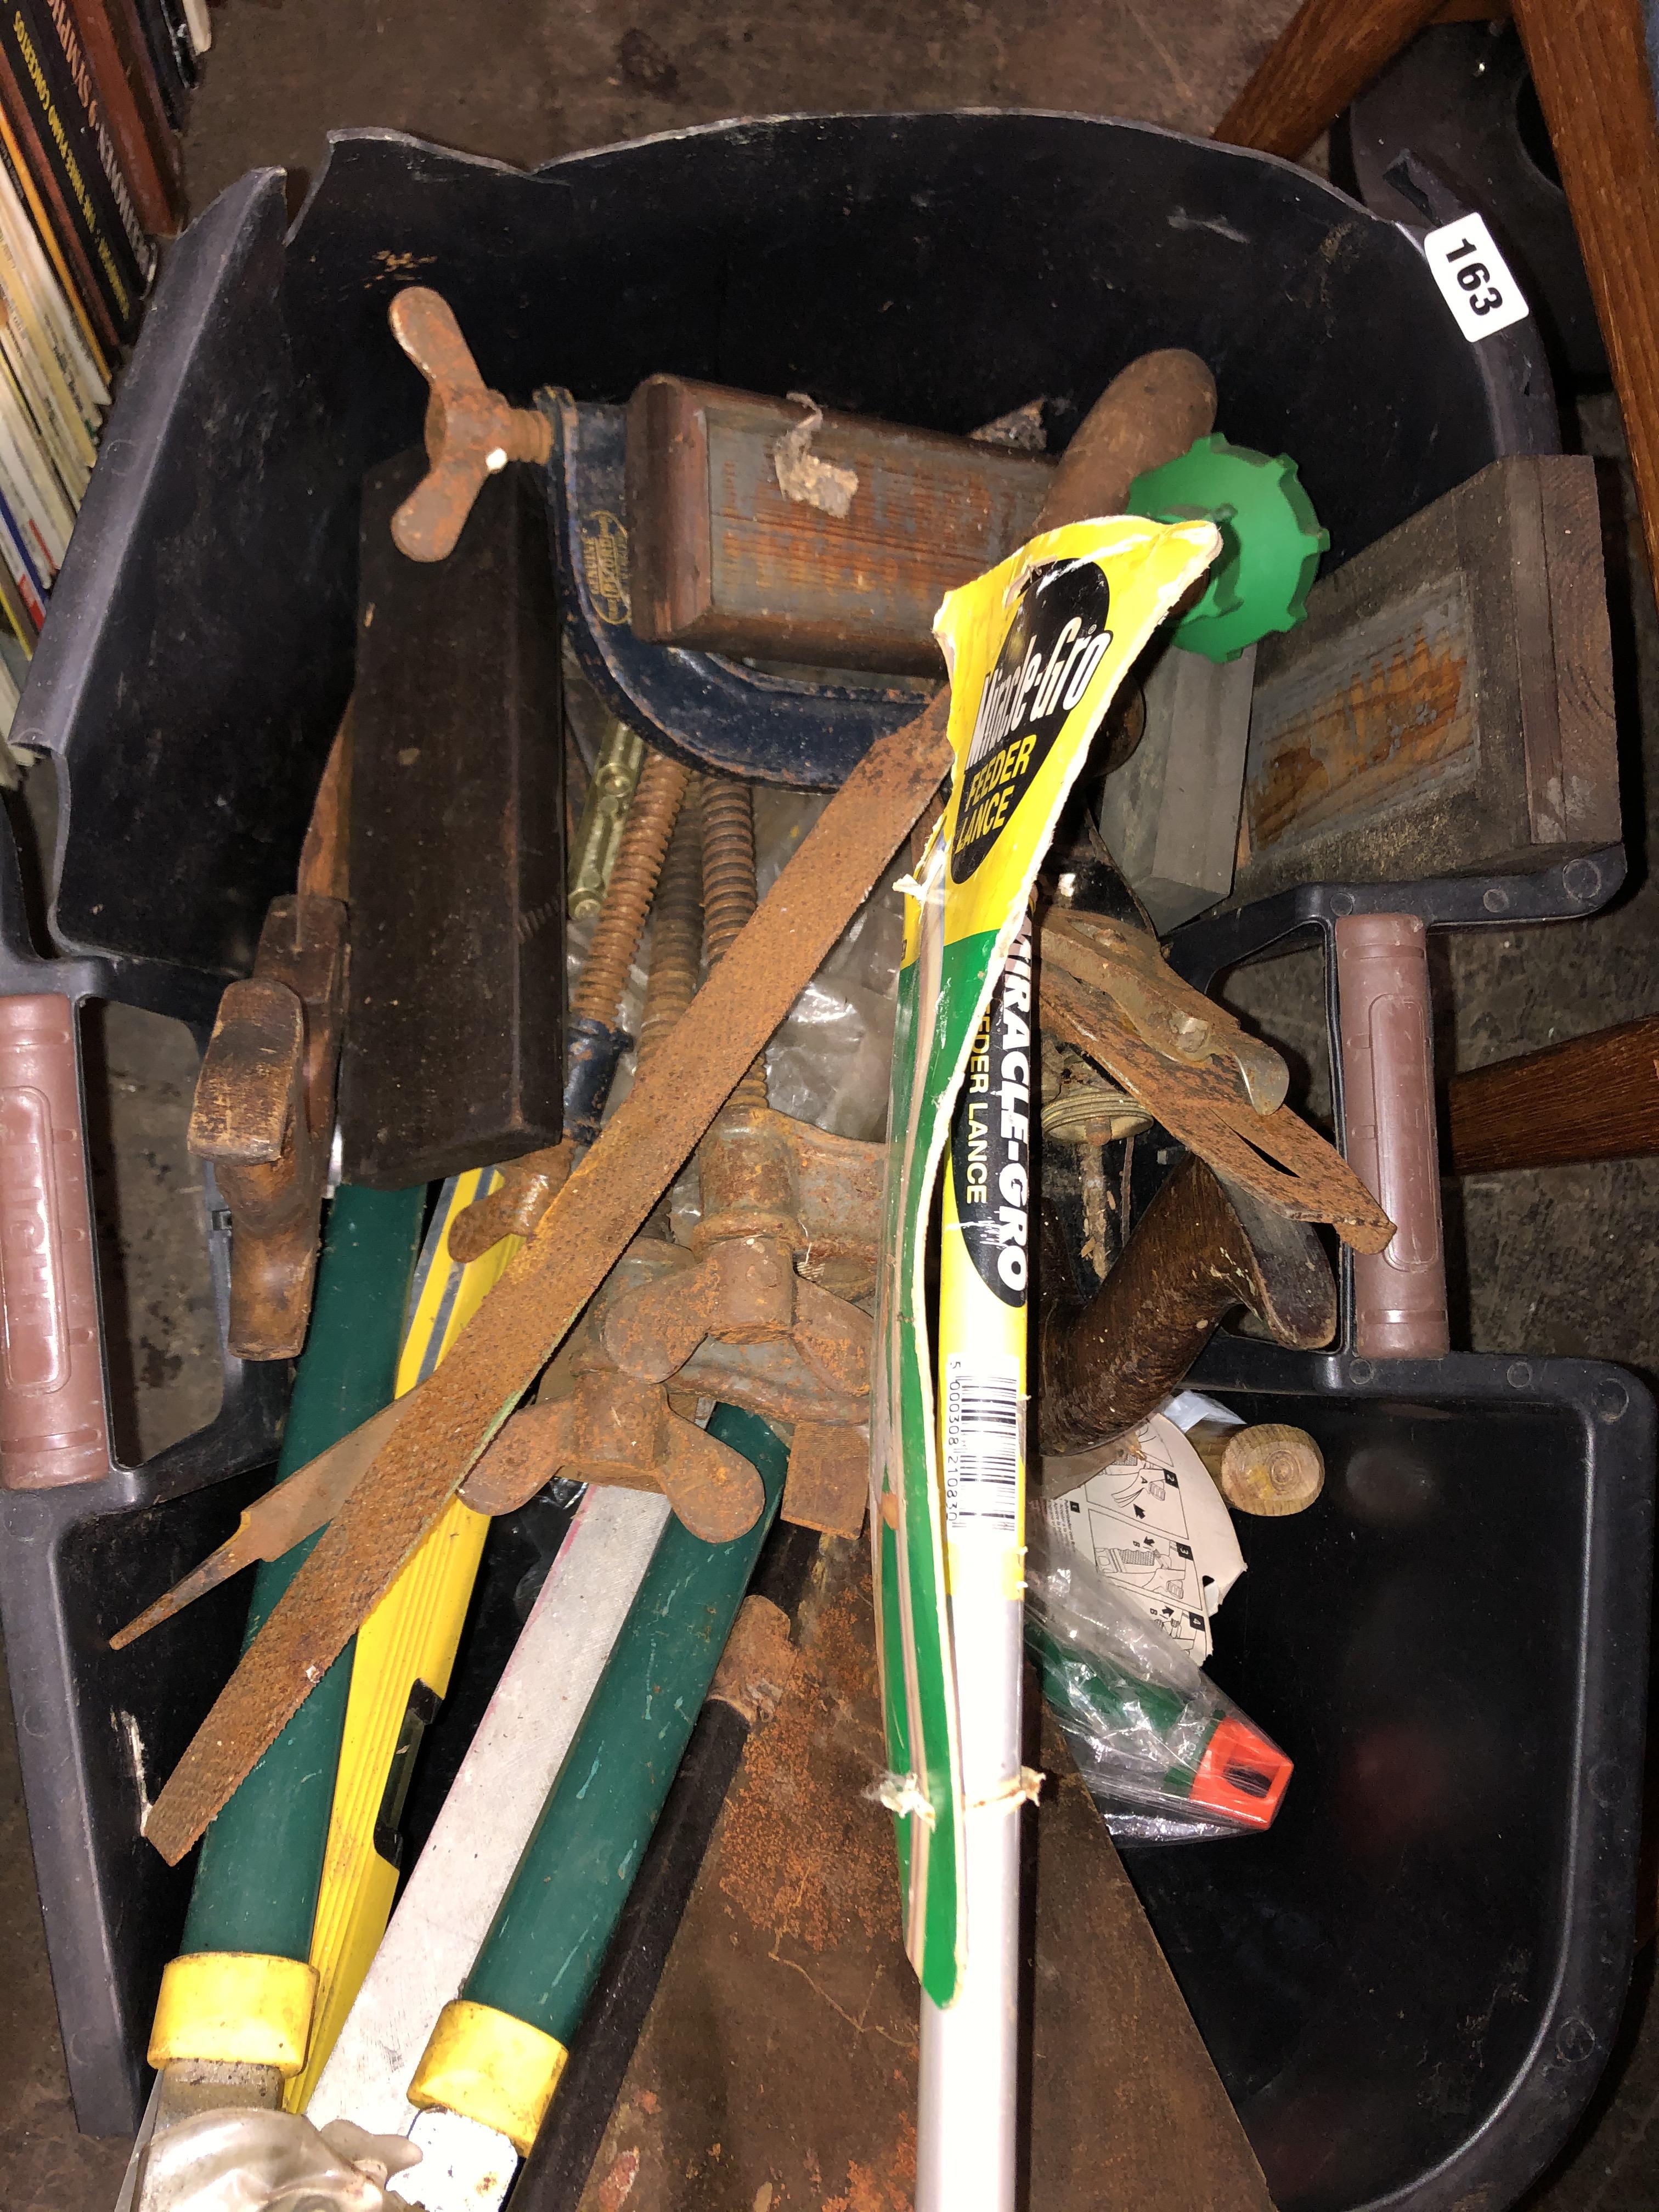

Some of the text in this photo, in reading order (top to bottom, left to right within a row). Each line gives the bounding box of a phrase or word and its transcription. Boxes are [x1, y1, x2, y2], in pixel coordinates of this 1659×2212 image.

[1446, 238, 1503, 317] 163
[965, 617, 1112, 770] Miracle-Gro
[965, 735, 1037, 812] FEEDER
[955, 785, 1015, 854] LANCE
[967, 1103, 988, 1204] LANCE
